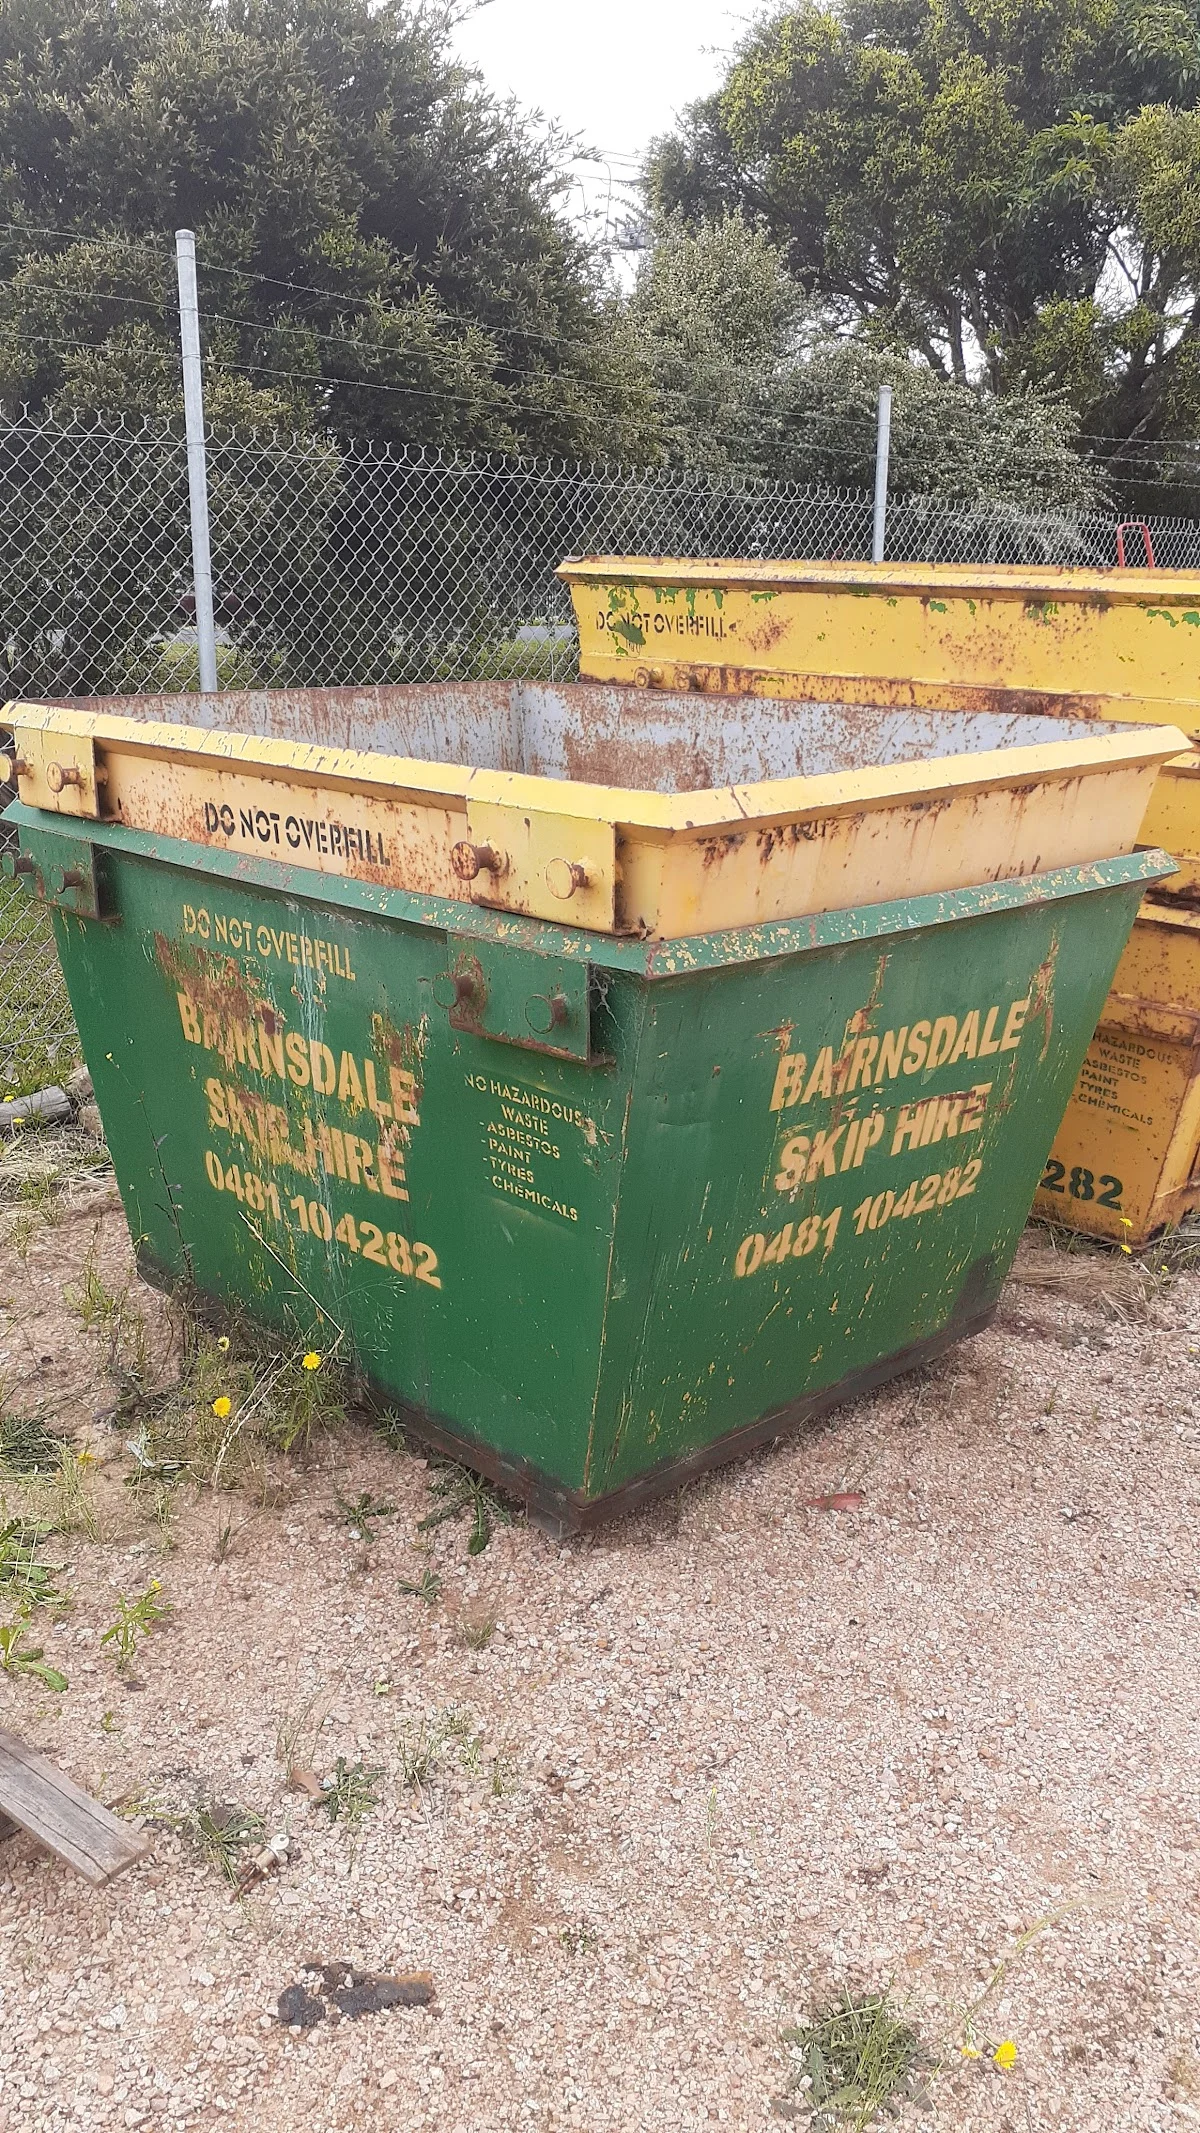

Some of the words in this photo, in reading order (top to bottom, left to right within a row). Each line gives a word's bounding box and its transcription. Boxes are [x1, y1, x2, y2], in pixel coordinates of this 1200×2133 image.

[653, 613, 727, 638] OVERFILL
[204, 801, 236, 837] DO
[240, 808, 280, 844] NOT
[285, 815, 391, 867] OVERFILL
[182, 904, 211, 939] DO
[214, 914, 252, 951] NOT
[256, 925, 356, 982] OVERFILL
[769, 1000, 1029, 1111] BAIRNSDALE
[1093, 1032, 1173, 1066] HAZARDOUS
[1099, 1046, 1141, 1070] WASTE
[1080, 1080, 1118, 1100] TYRES
[1081, 1069, 1119, 1087] PAINT
[1083, 1058, 1148, 1085] ASBESTOS
[464, 1073, 487, 1092] NO
[490, 1079, 584, 1127] HAZARDOUS
[501, 1103, 549, 1136] WASTE
[1079, 1093, 1153, 1126] CHEMICALS
[206, 1078, 290, 1165] SKIP
[303, 1115, 410, 1203] HIRE
[774, 1112, 885, 1191] SKIP
[890, 1082, 993, 1157] HIRE
[205, 1150, 282, 1221] 0481
[290, 1194, 442, 1289] 104282
[734, 1206, 842, 1279] 0481
[853, 1158, 983, 1236] 104282
